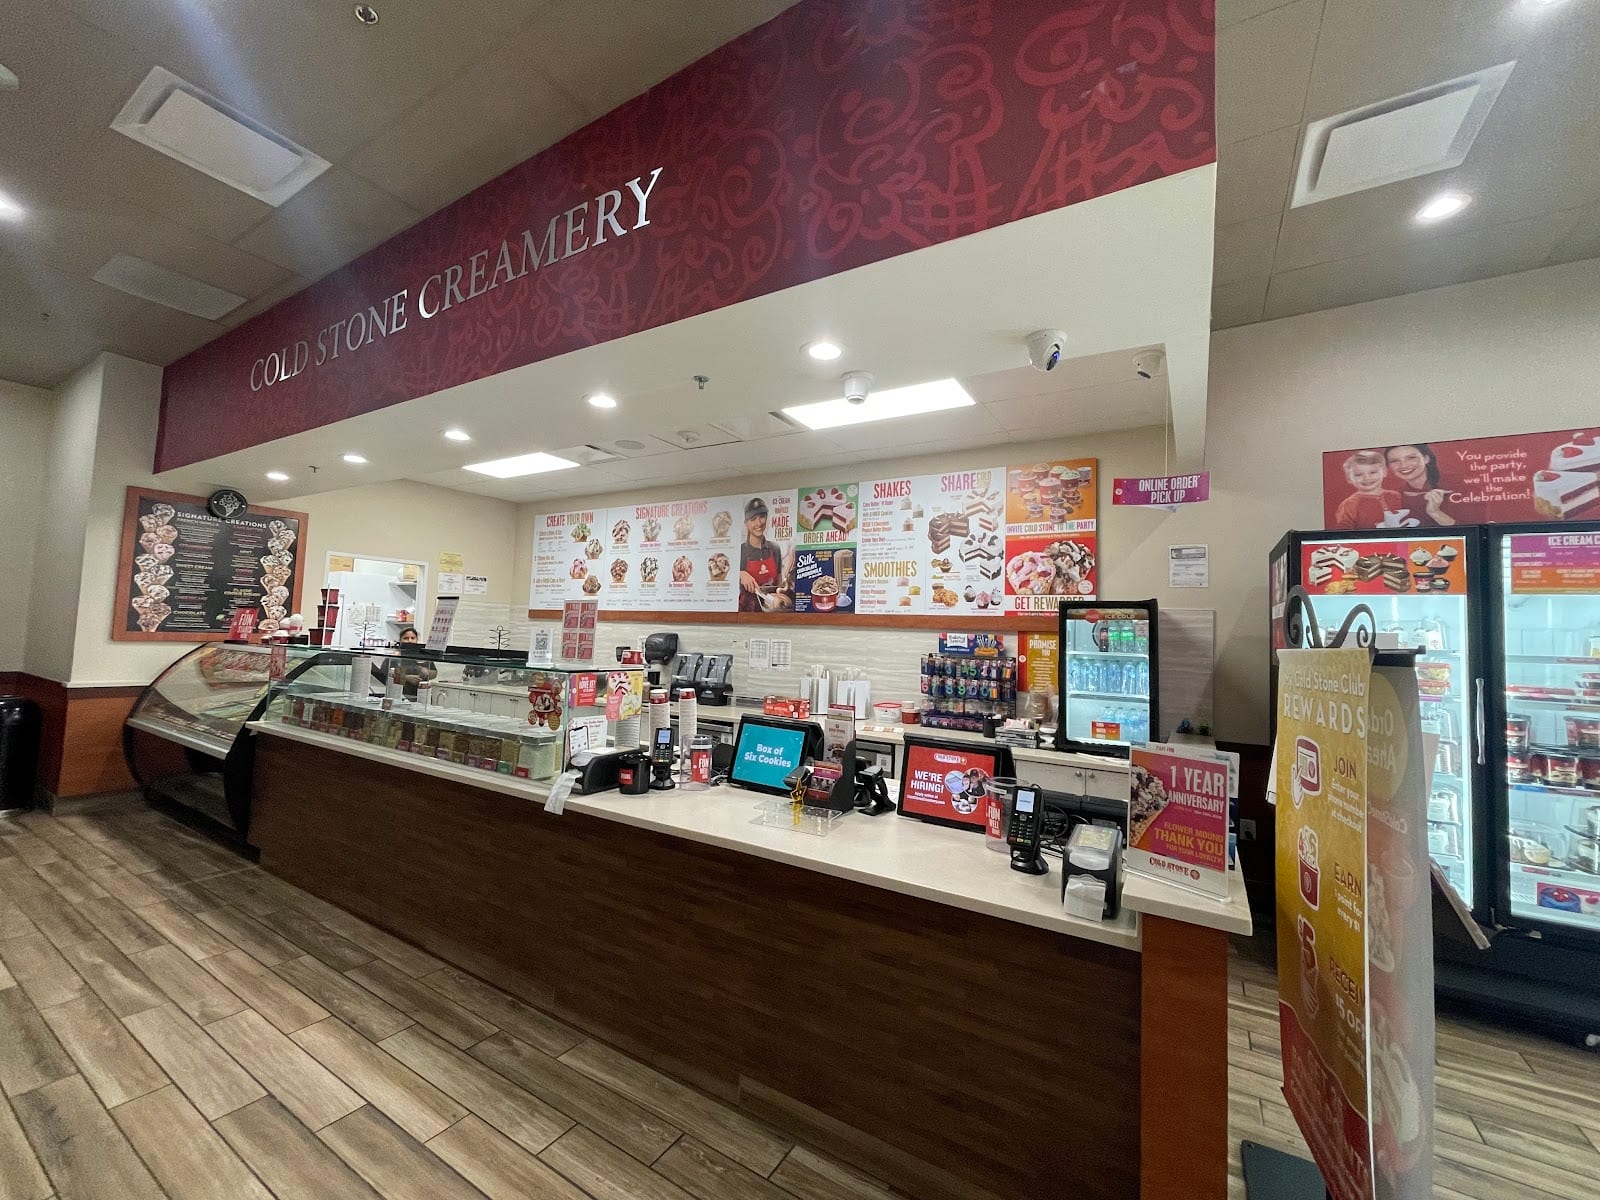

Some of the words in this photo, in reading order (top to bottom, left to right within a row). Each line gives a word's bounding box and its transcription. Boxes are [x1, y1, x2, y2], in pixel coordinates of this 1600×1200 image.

[249, 340, 309, 392] COLD
[316, 289, 408, 367] STONE
[418, 166, 664, 320] CREAMERY
[1456, 450, 1482, 462] You
[1484, 448, 1527, 463] provide
[1470, 462, 1487, 471] the
[1490, 460, 1527, 472] party,
[941, 472, 976, 493] SHARE
[1139, 478, 1168, 492] ONLINE
[1170, 475, 1198, 489] ORDER
[1464, 473, 1490, 484] we'll
[1492, 471, 1526, 482] make
[873, 480, 911, 499] SHAKES
[1486, 483, 1503, 492] the
[1151, 491, 1171, 503] PICK
[1173, 490, 1185, 502] UP
[1449, 488, 1531, 504] Celebration!
[635, 504, 669, 520] SIGNATURE
[671, 500, 708, 517] CREATIONS
[177, 511, 222, 523] SIGNATURE
[226, 519, 267, 529] CREATIONS
[546, 514, 565, 527] CREATE
[772, 515, 790, 528] MADE
[1006, 525, 1023, 533] INVITE
[1024, 523, 1037, 532] COLD
[1038, 522, 1055, 531] STONE
[1065, 521, 1074, 530] THE
[1076, 520, 1094, 529] PARTY
[774, 527, 792, 539] FRESH
[803, 531, 824, 544] ORDER
[1547, 536, 1562, 546] ICE
[1562, 535, 1593, 546] CREAM
[797, 553, 815, 568] Silk
[864, 560, 917, 578] SMOOTHIES
[1015, 596, 1030, 610] GET
[1029, 639, 1057, 650] PROMISE
[1295, 670, 1312, 689] Cold
[1314, 671, 1339, 693] Stone
[1341, 672, 1365, 697] Club
[1283, 693, 1366, 738] REWARDS
[756, 743, 773, 754] Box
[773, 746, 784, 755] of
[744, 751, 757, 762] Six
[758, 754, 792, 768] Cookies
[1334, 755, 1357, 781] JOIN
[914, 770, 943, 783] WE'RE
[1170, 765, 1177, 788] 1
[1183, 767, 1225, 798] YEAR
[910, 780, 944, 793] HIRING!
[1168, 790, 1225, 813] ANNIVERSARY
[1164, 821, 1194, 836] FLOWER
[1194, 829, 1223, 842] MOUND
[1154, 827, 1194, 848] THANK
[1197, 838, 1223, 856] YOU
[1149, 857, 1167, 869] COLD
[1167, 862, 1189, 876] STONE
[1335, 861, 1362, 897] EARN
